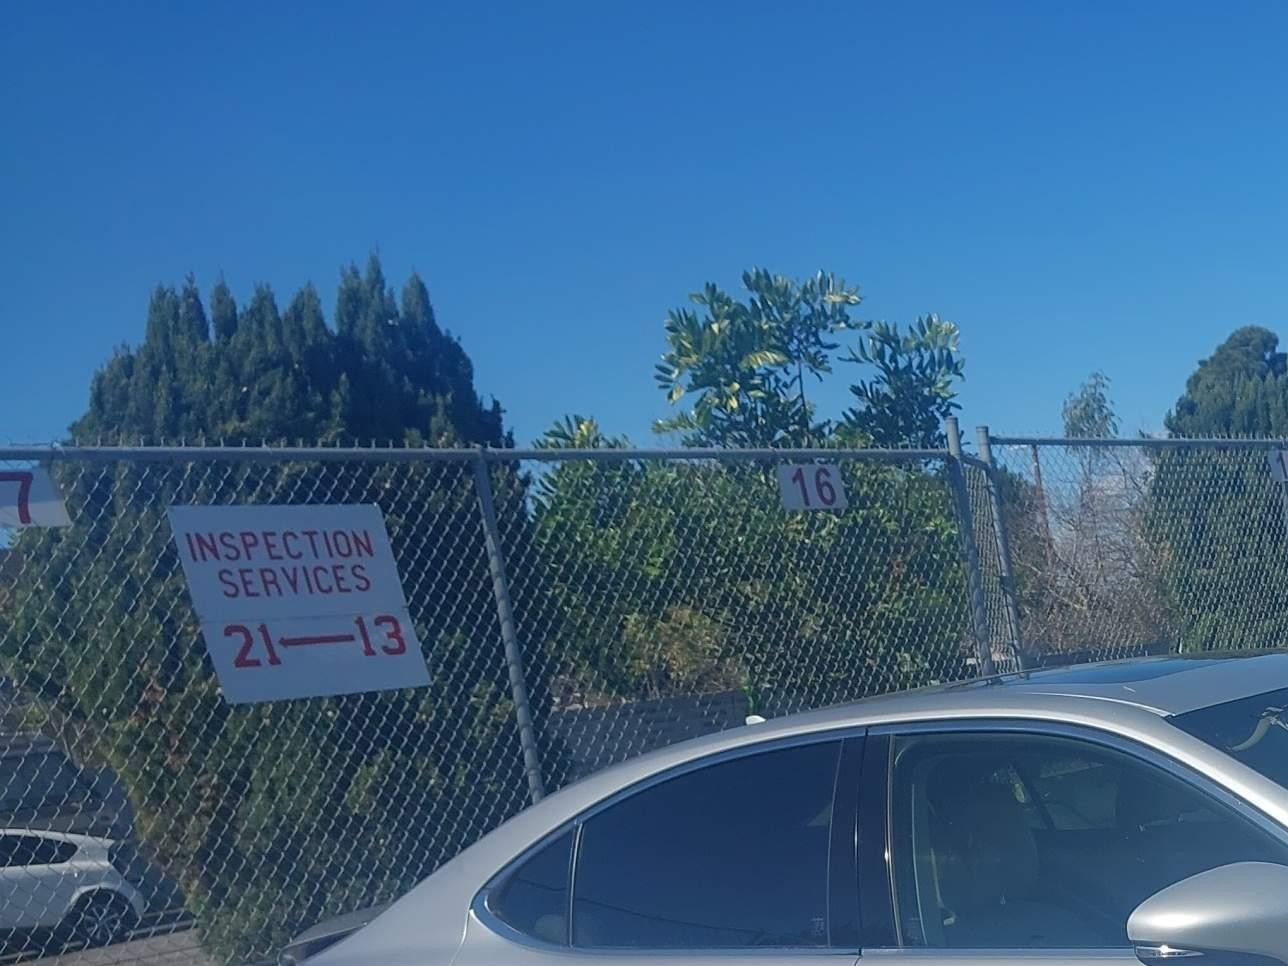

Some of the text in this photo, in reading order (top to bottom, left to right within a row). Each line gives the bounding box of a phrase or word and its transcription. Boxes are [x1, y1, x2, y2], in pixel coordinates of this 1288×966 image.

[792, 467, 837, 507] 16
[186, 529, 375, 562] INSPECTION
[218, 564, 371, 599] SERVICES
[223, 615, 407, 668] 21 13
